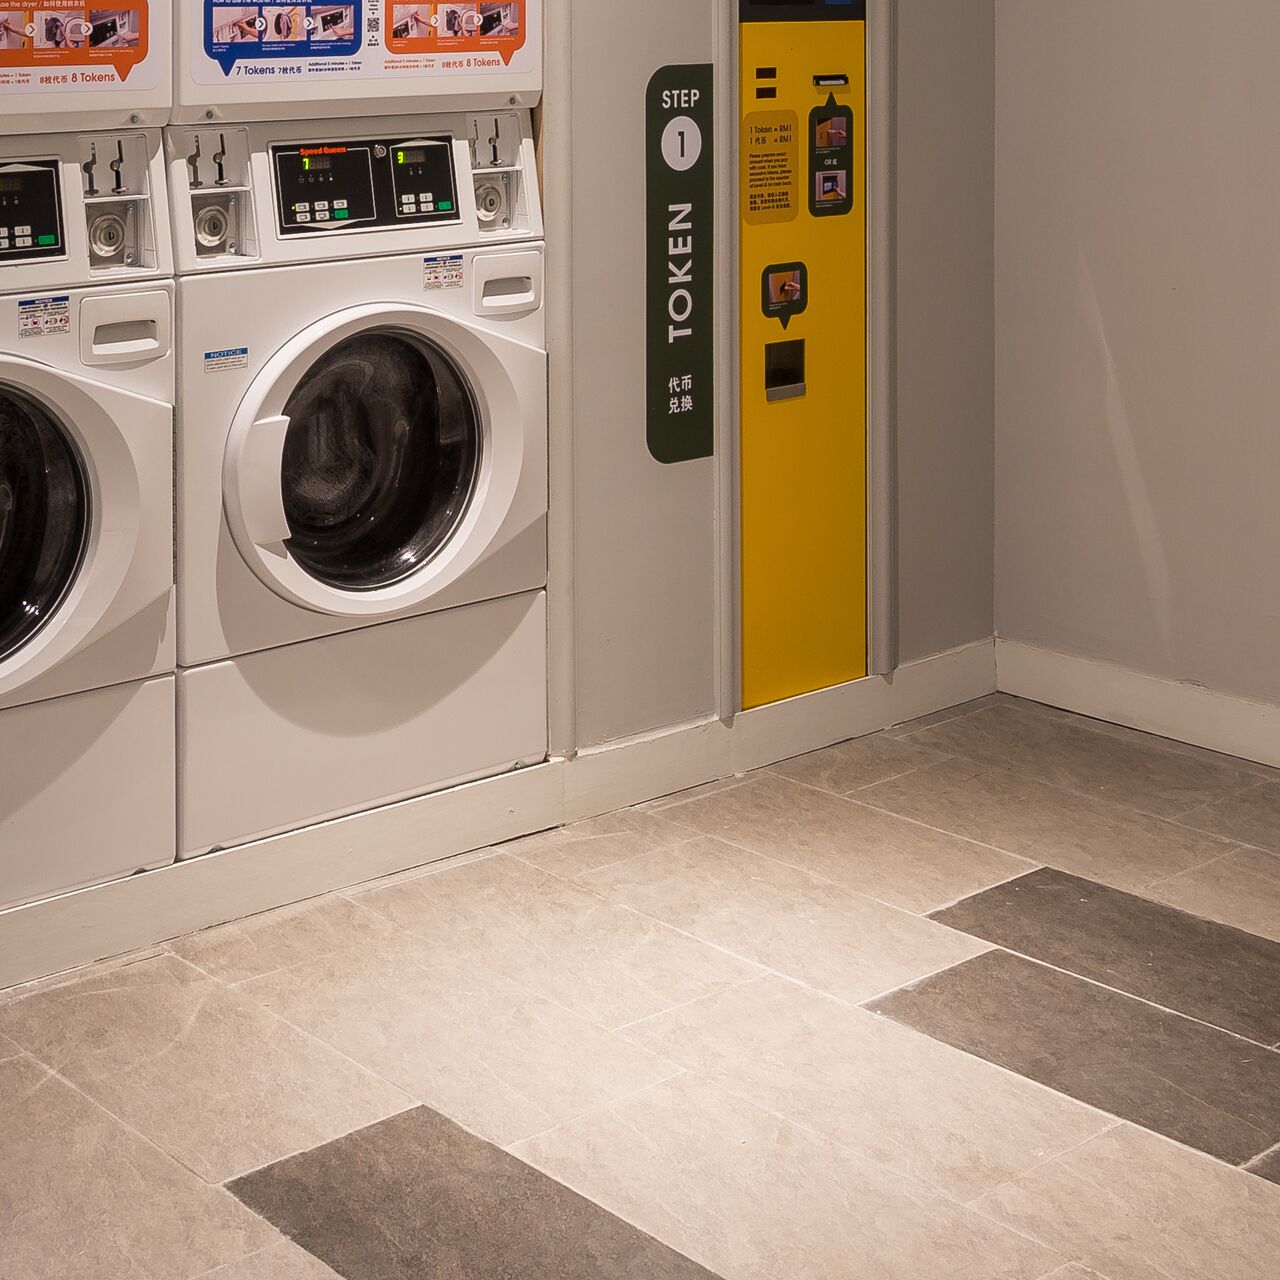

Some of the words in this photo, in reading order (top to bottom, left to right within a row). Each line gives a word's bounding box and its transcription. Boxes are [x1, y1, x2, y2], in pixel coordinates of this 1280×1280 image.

[236, 66, 241, 76] 7
[243, 65, 276, 75] Tokens
[466, 59, 471, 68] 8
[473, 58, 500, 67] Tokens
[71, 73, 78, 83] 8
[80, 72, 115, 82] Tokens
[662, 89, 699, 109] STEP
[676, 130, 685, 158] 1
[300, 148, 322, 156] Speed
[668, 202, 693, 344] TOKEN
[210, 350, 240, 358] NOTICE
[668, 374, 692, 394] 代币
[668, 394, 693, 414] 兑换
